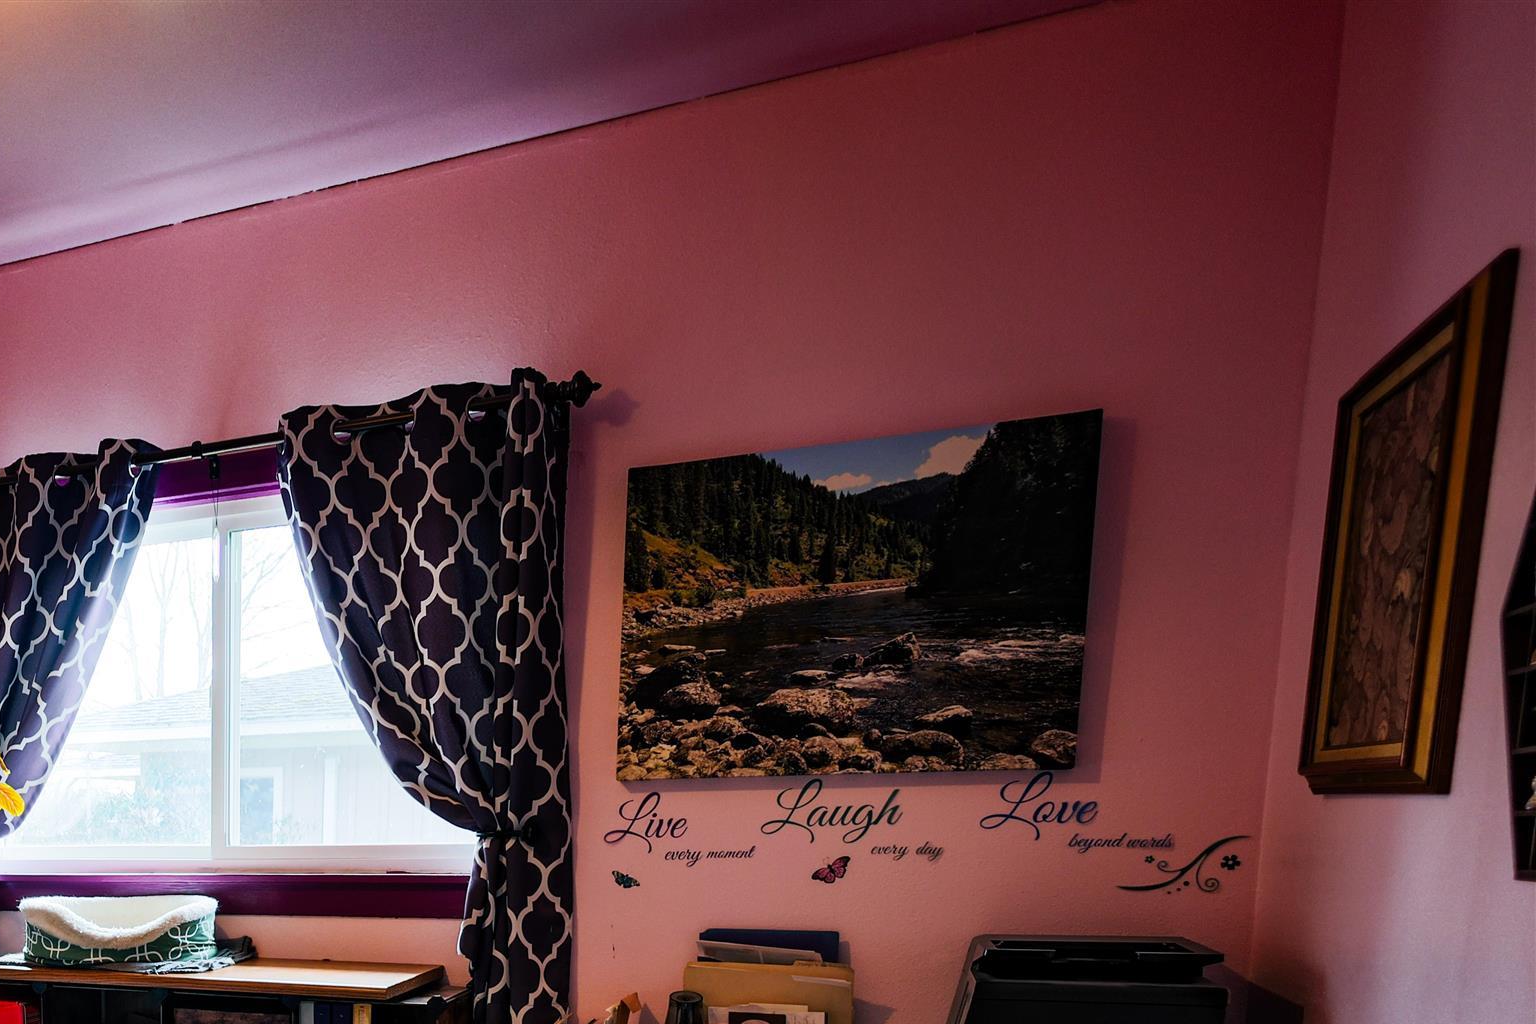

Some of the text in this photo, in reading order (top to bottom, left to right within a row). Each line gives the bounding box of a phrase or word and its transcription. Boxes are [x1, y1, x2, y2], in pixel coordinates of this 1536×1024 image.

[604, 792, 688, 853] Live
[761, 778, 902, 843] Laugh
[979, 771, 1098, 840] Love
[664, 845, 756, 867] every moment
[871, 841, 945, 860] every day
[1068, 833, 1175, 853] beyond words
